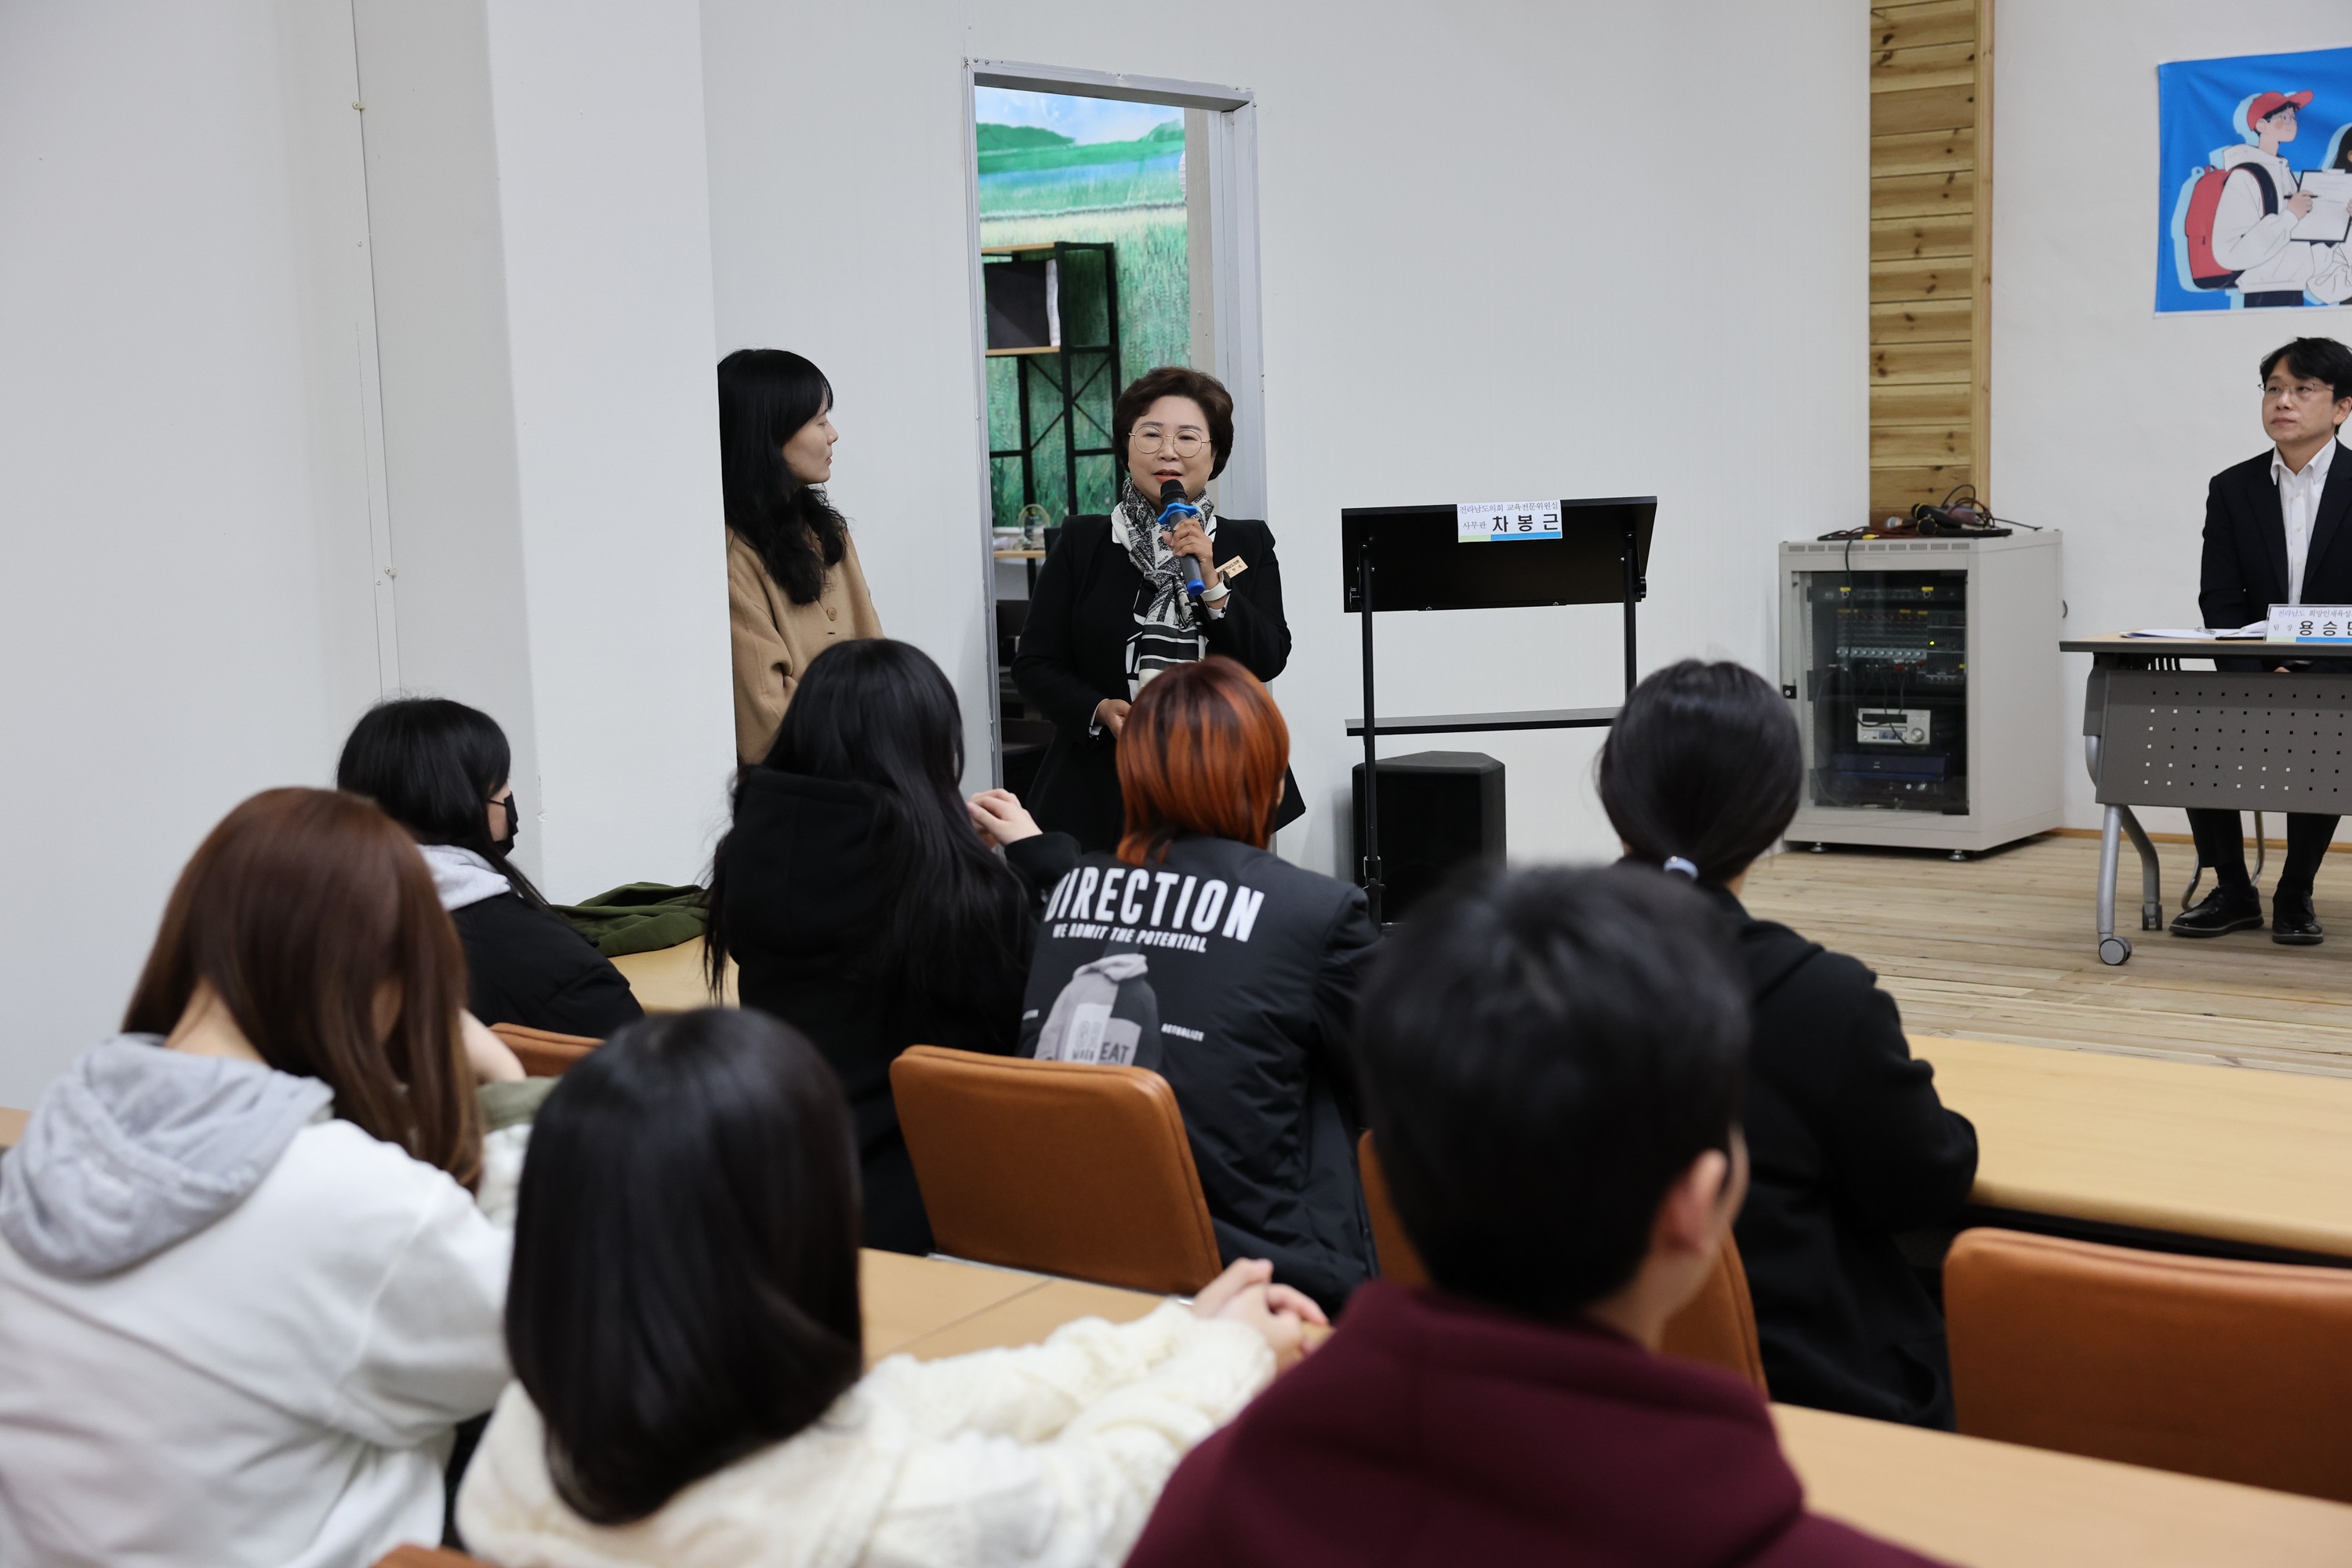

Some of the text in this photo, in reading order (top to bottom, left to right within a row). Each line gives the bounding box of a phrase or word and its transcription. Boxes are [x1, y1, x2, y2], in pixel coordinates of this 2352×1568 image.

[1460, 502, 1559, 514] 전라남도의회 교육전문위원실
[1462, 521, 1486, 529] 사무관
[2309, 609, 2352, 618] 희망인재육성
[1044, 866, 1265, 943] DIRECTION
[1052, 923, 1208, 953] WE ADMIT THE POTENTIAL
